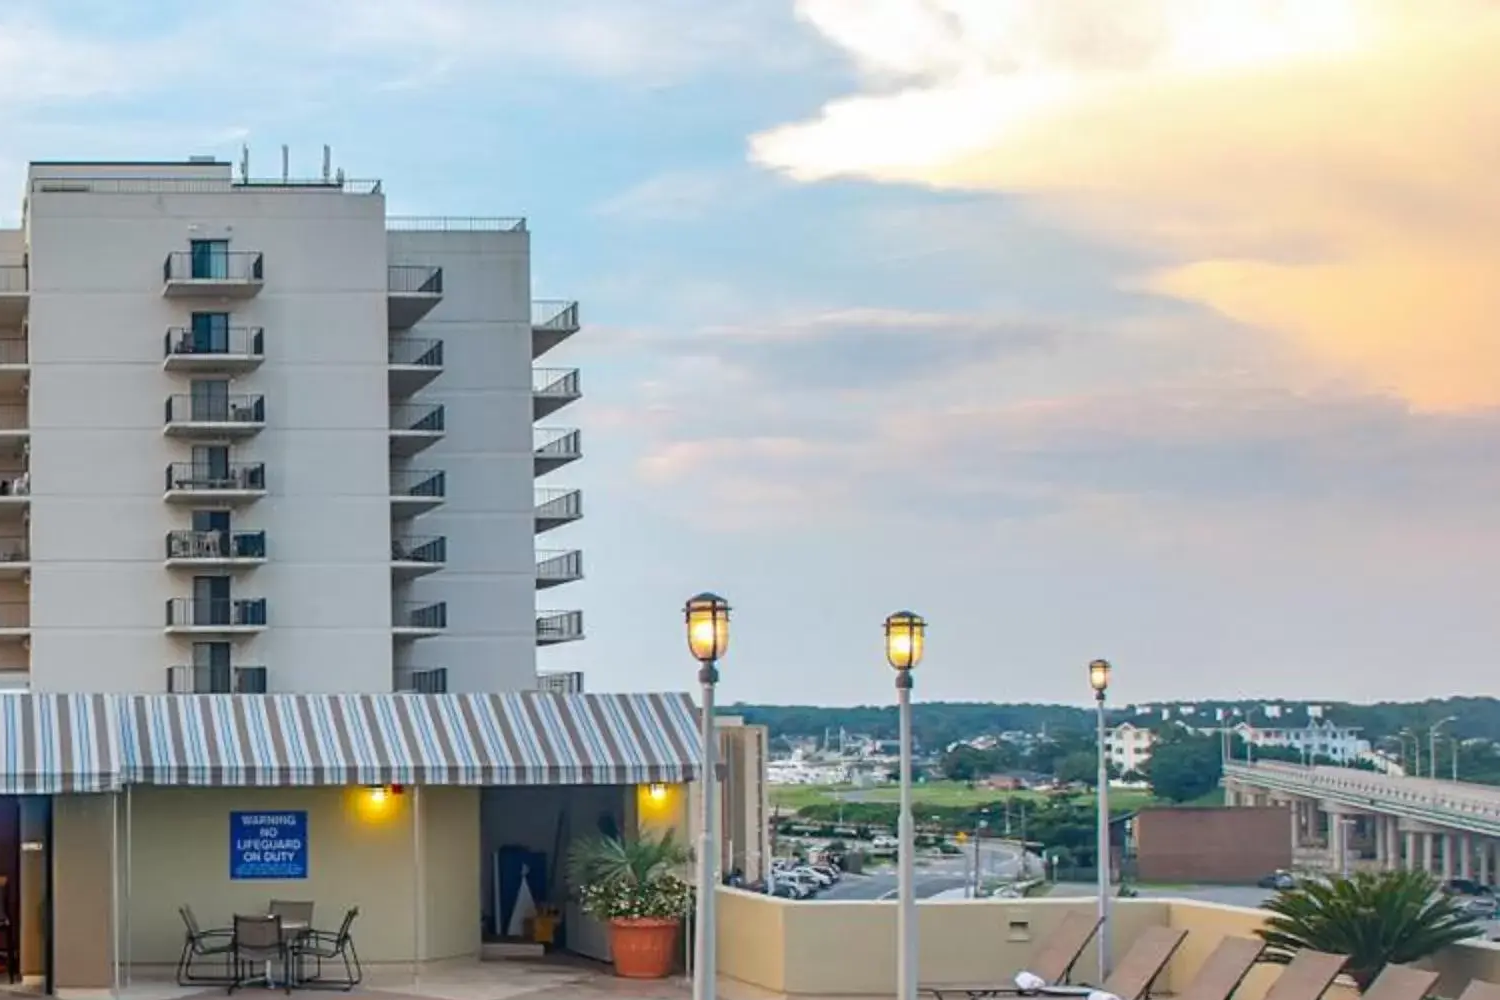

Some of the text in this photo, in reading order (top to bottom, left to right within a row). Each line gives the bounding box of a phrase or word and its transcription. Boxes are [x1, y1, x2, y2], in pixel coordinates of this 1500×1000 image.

[260, 826, 278, 838] NO
[237, 838, 301, 850] LIFEGUARD
[243, 851, 295, 862] ON DUTY
